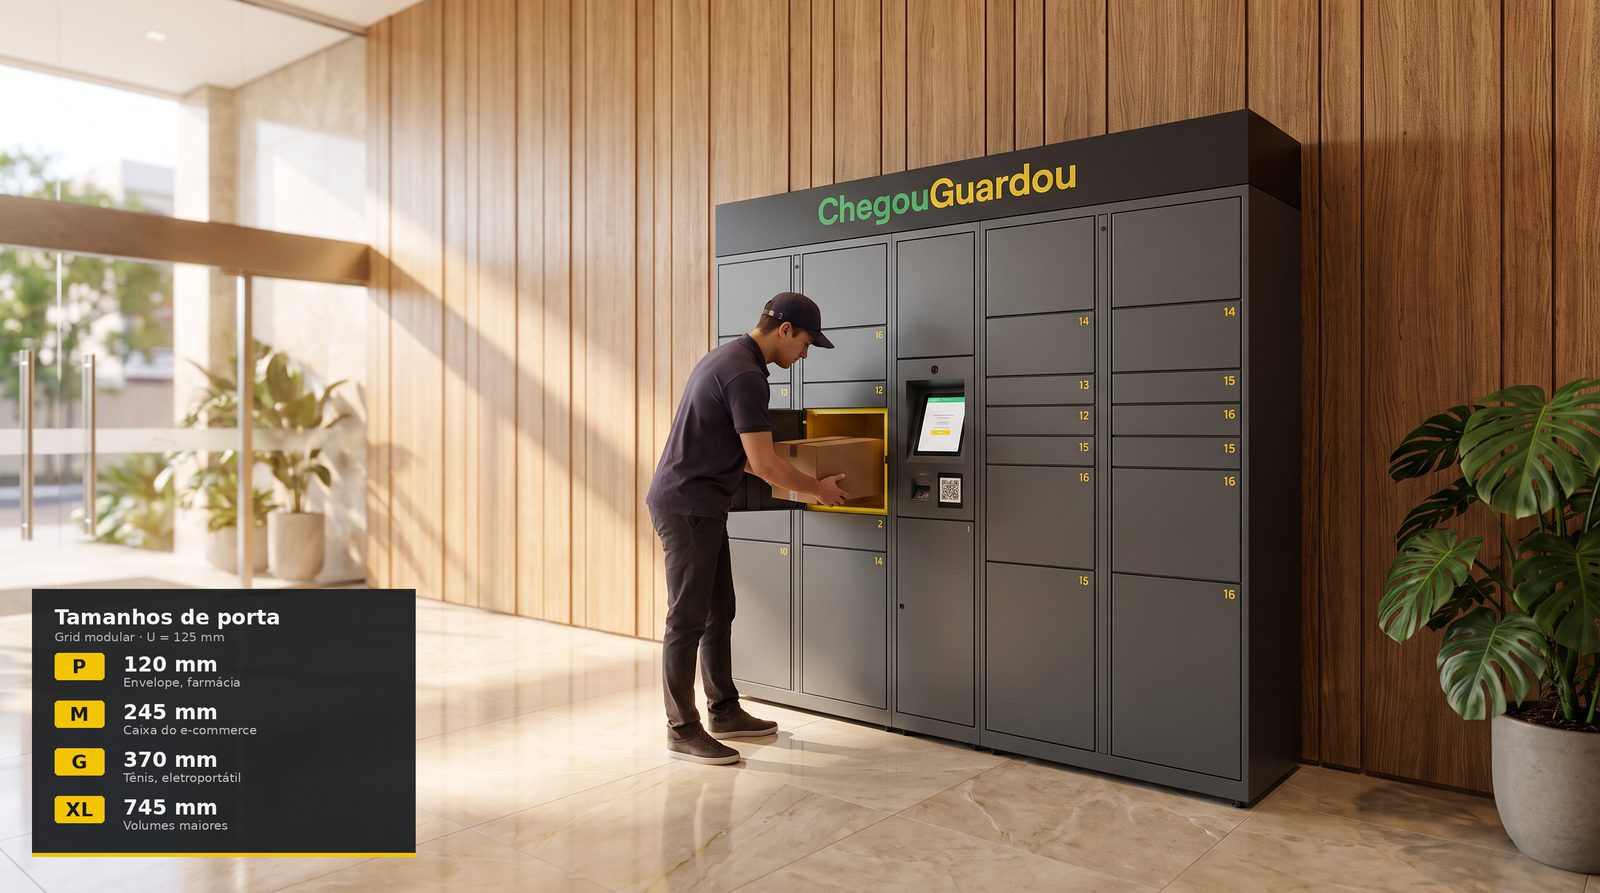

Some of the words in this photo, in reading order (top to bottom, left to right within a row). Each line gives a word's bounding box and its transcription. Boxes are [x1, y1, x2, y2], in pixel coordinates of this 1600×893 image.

[818, 162, 1077, 226] ChegouGuardou
[1223, 305, 1237, 318] 14
[1078, 315, 1090, 327] 14
[875, 330, 884, 340] 16
[1079, 379, 1090, 391] 13
[1223, 374, 1237, 388] 15
[780, 387, 789, 397] 13
[875, 385, 884, 395] 12
[1078, 409, 1090, 422] 12
[1223, 408, 1237, 421] 16
[1079, 440, 1090, 453] 15
[1223, 442, 1237, 455] 15
[1079, 471, 1090, 484] 16
[1223, 475, 1237, 488] 16
[876, 519, 884, 529] 2
[779, 547, 789, 557] 10
[874, 556, 884, 566] 14
[1078, 575, 1089, 587] 15
[1222, 587, 1237, 601] 16
